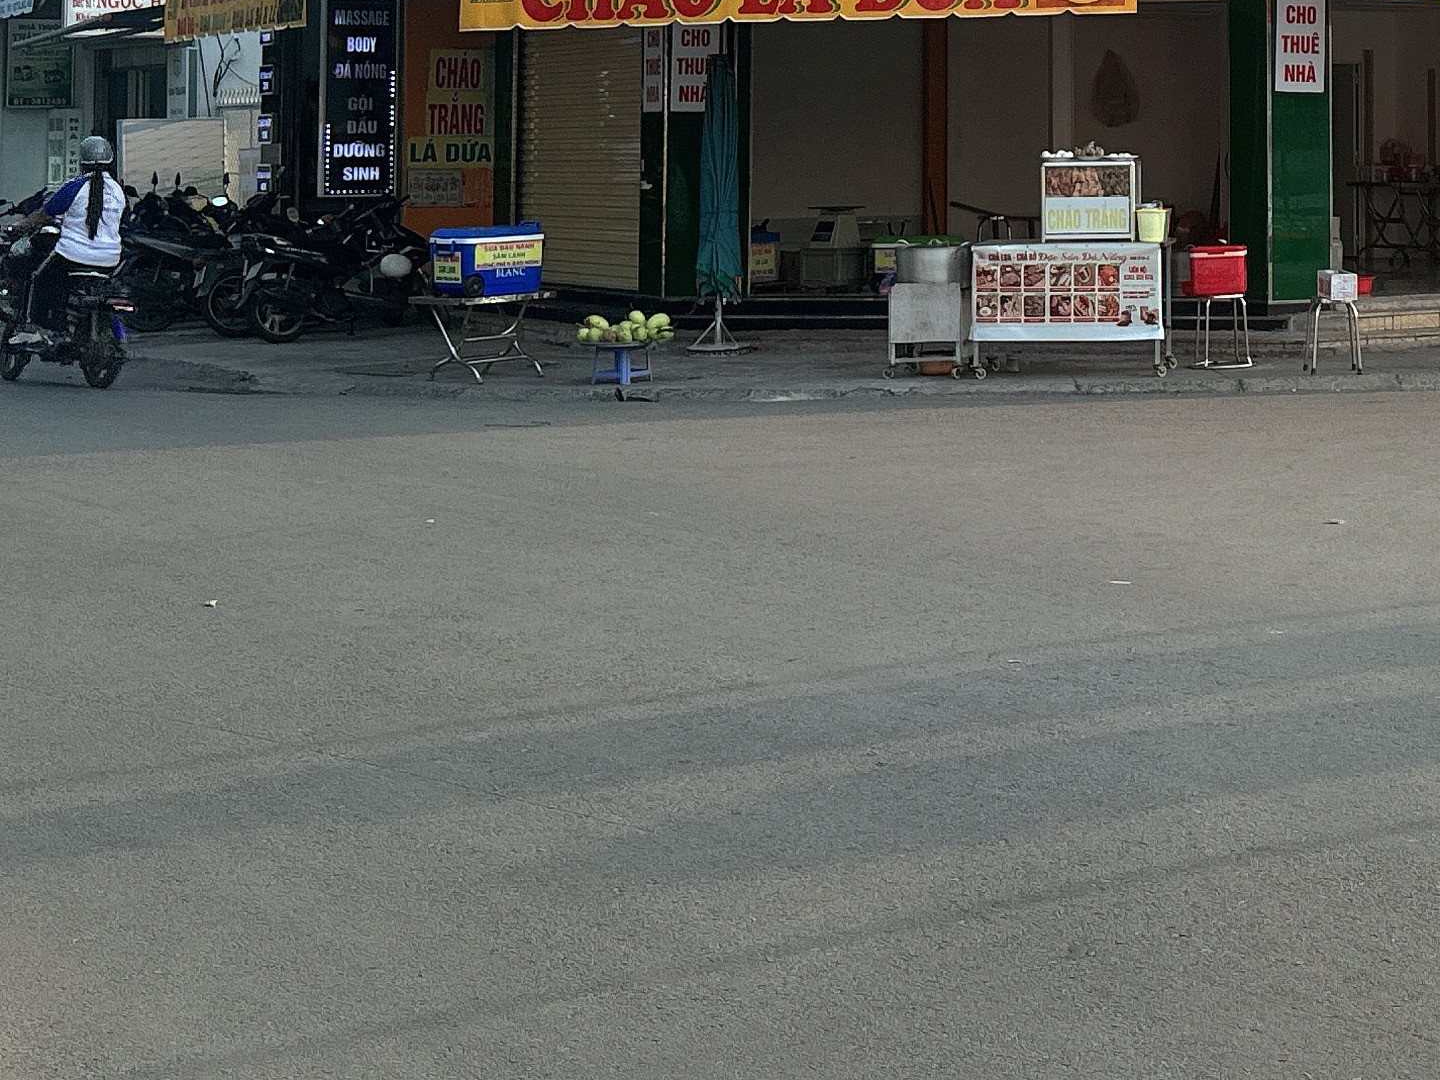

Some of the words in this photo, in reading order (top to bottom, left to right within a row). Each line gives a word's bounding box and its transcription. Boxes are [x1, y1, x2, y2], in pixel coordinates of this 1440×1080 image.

[334, 9, 390, 26] MASSAGE
[1285, 4, 1317, 25] CHO
[346, 36, 377, 53] BODY
[682, 29, 711, 47] CHO
[1281, 31, 1320, 55] THUÊ
[354, 60, 387, 79] NÓNG
[434, 51, 481, 90] CHÁO
[1284, 60, 1317, 83] NHÀ
[428, 91, 485, 135] TRẮNG
[333, 139, 385, 158] DƯỠNG
[410, 137, 438, 163] LÁ
[342, 166, 380, 182] SINH
